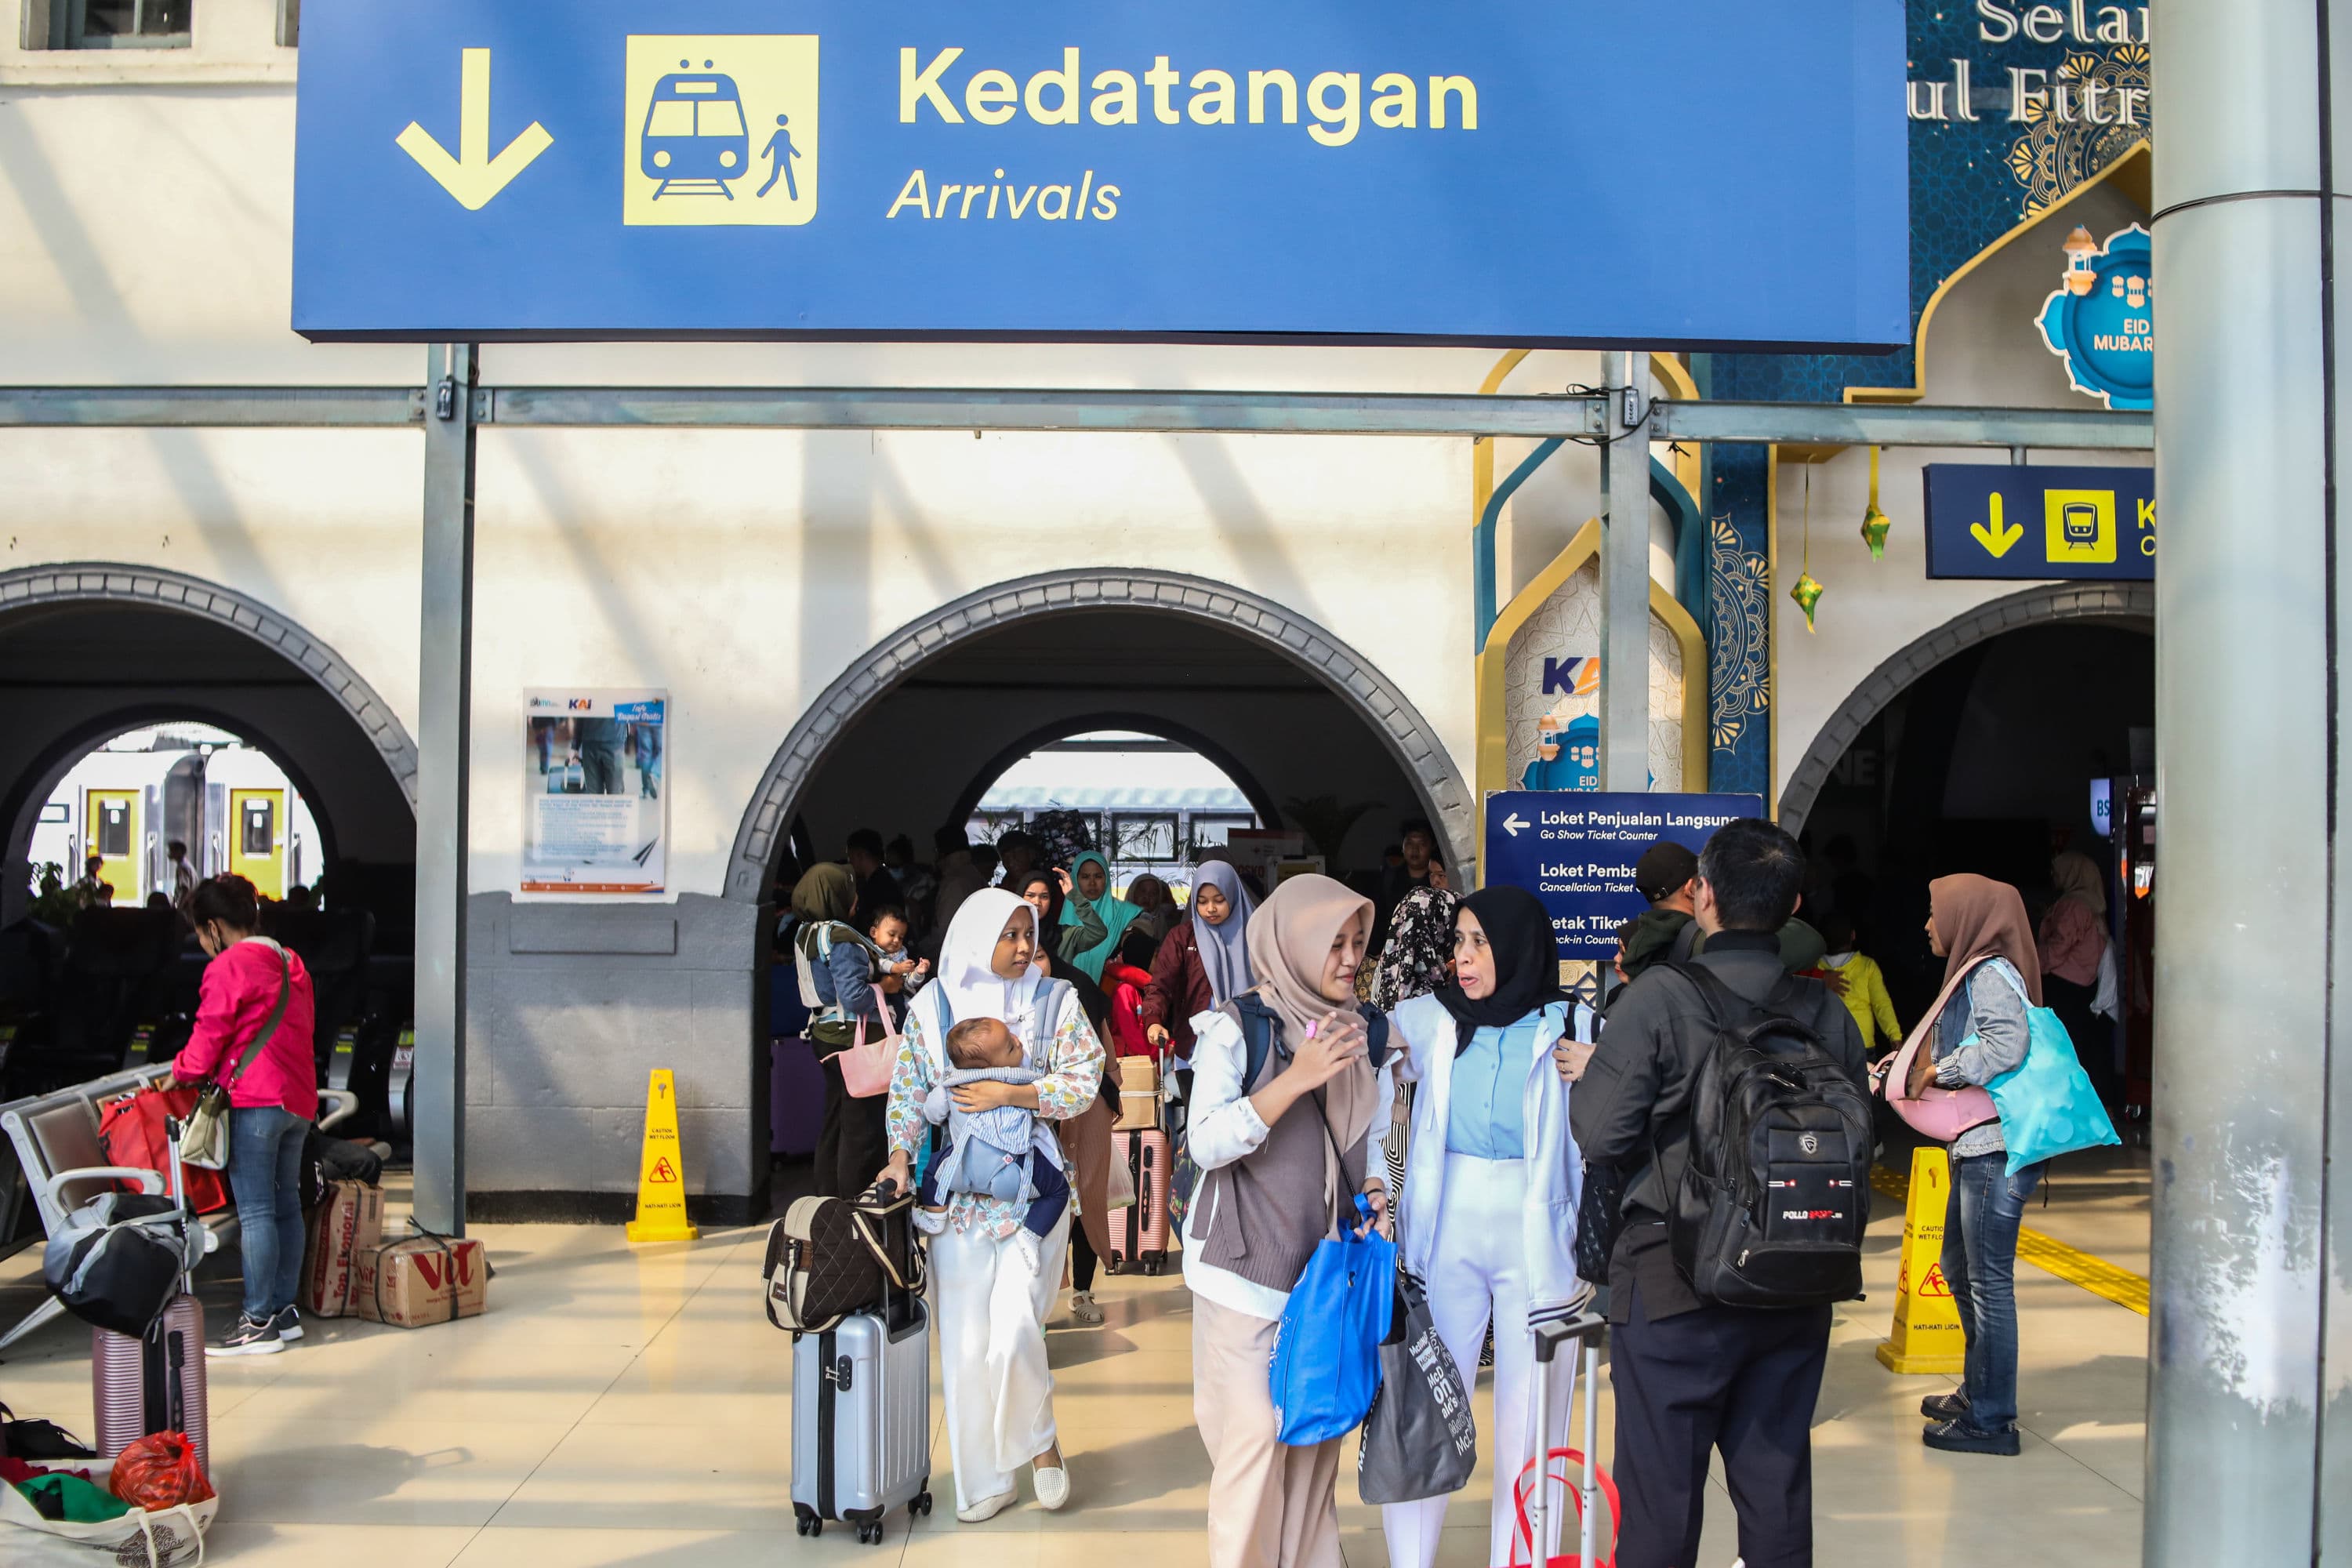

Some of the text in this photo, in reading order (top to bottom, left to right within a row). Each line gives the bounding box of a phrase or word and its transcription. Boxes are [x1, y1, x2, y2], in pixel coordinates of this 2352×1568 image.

[899, 46, 1479, 147] Kedatangan
[886, 167, 1121, 221] Arrivals
[2123, 318, 2151, 335] EID
[2093, 334, 2154, 351] MUBAR
[568, 699, 592, 710] KAI
[1579, 775, 1599, 786] EID
[1541, 811, 1740, 829] Loket Penjualan Langsun
[1540, 829, 1658, 840] Go Show Ticket Counter
[1541, 863, 1637, 877] Loket Pemba
[1539, 882, 1602, 892] Cancellation
[1604, 883, 1634, 892] Ticket
[1550, 916, 1586, 930] etak
[1782, 1210, 1809, 1220] POLLO
[1427, 1366, 1444, 1389] McD
[1433, 1377, 1453, 1405] on
[1441, 1396, 1459, 1420] ald's
